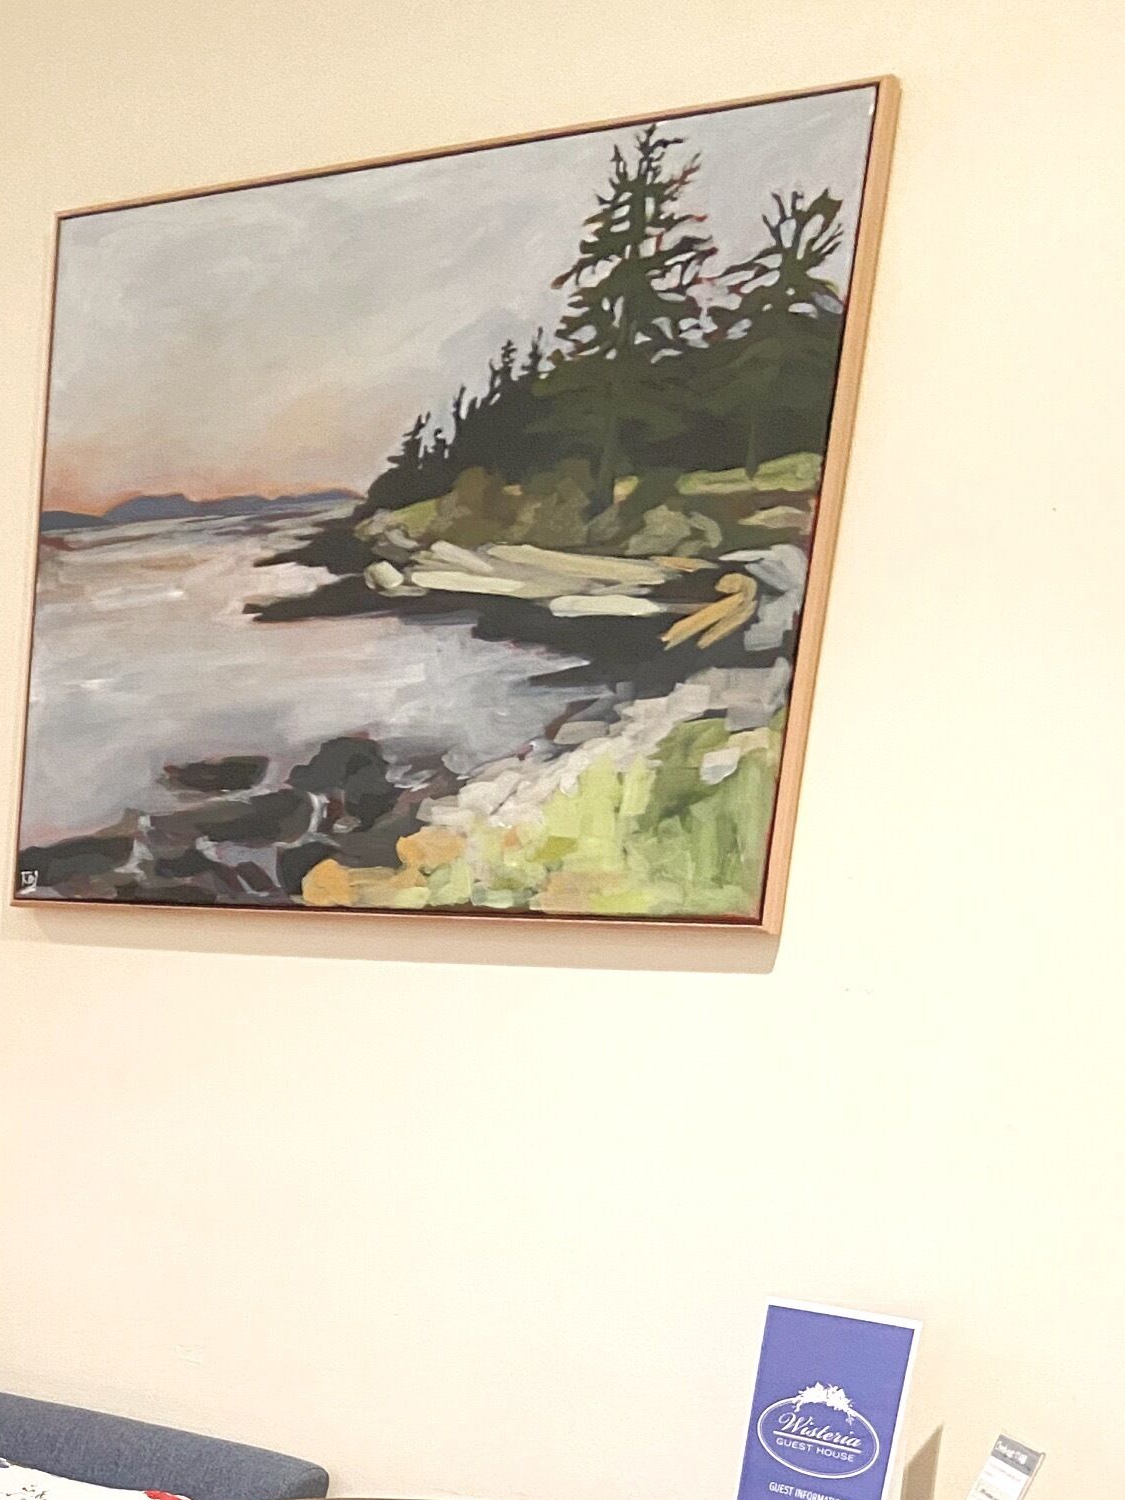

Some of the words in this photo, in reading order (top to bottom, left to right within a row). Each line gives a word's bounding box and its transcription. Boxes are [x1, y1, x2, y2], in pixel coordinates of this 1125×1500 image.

[778, 1412, 861, 1448] Wisteria
[776, 1437, 813, 1452] GUEST
[816, 1447, 855, 1462] HOUSE
[768, 1482, 794, 1496] GUEST
